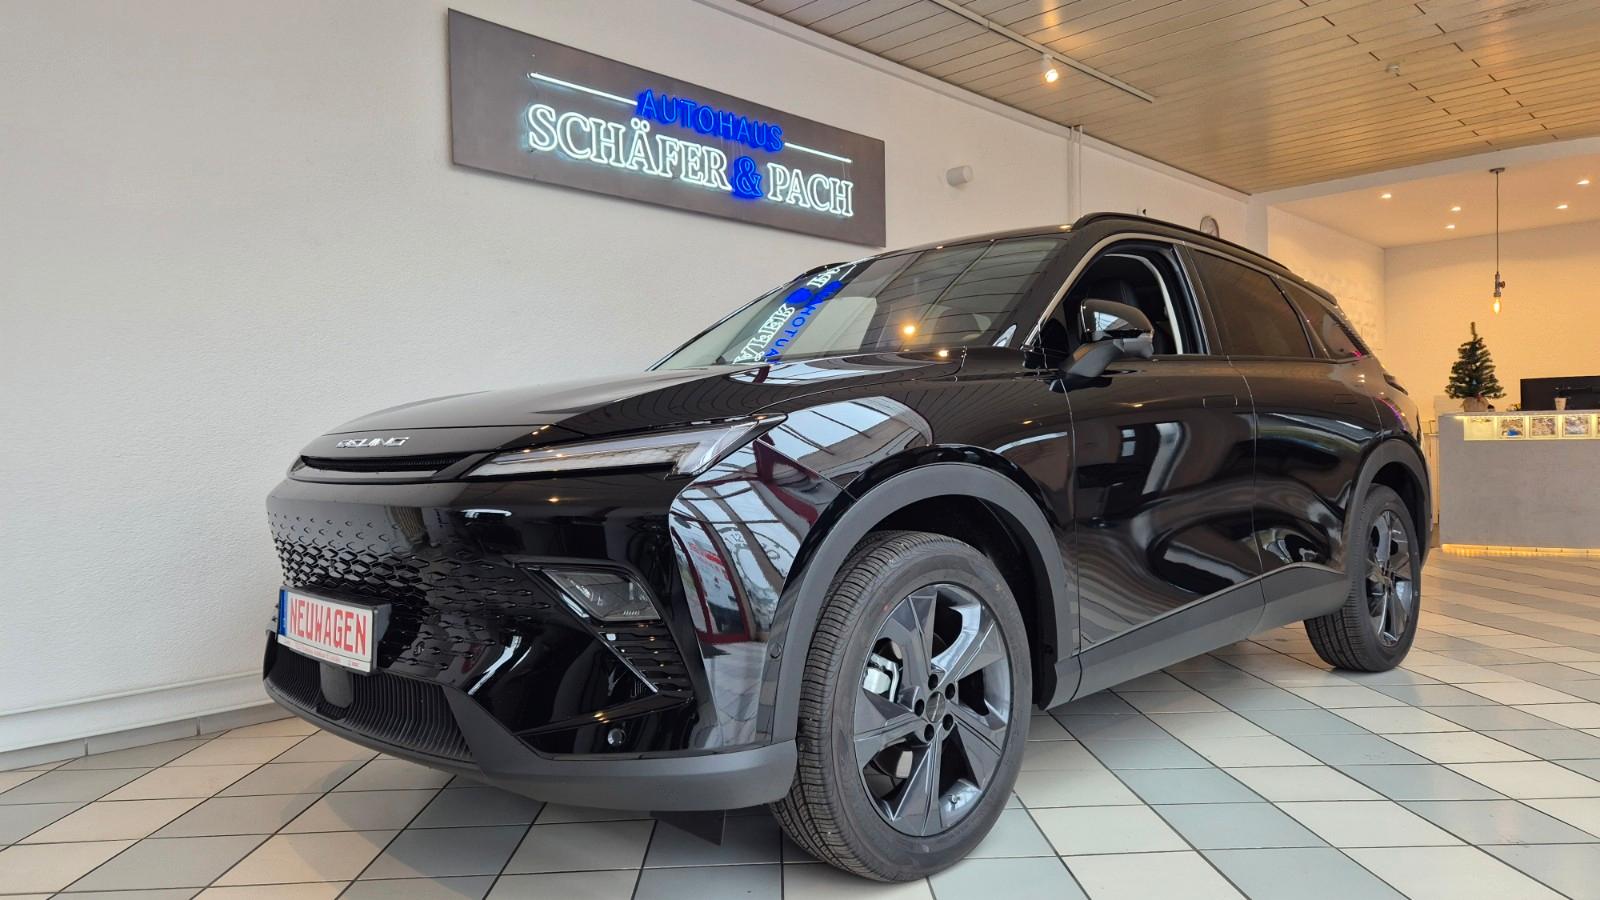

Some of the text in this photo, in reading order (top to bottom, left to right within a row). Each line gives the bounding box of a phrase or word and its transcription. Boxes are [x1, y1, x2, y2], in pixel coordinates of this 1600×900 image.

[639, 88, 784, 151] AUTOHAUS
[528, 103, 854, 216] SCHÄFER & PACH
[290, 598, 367, 656] NEUWAGEN
